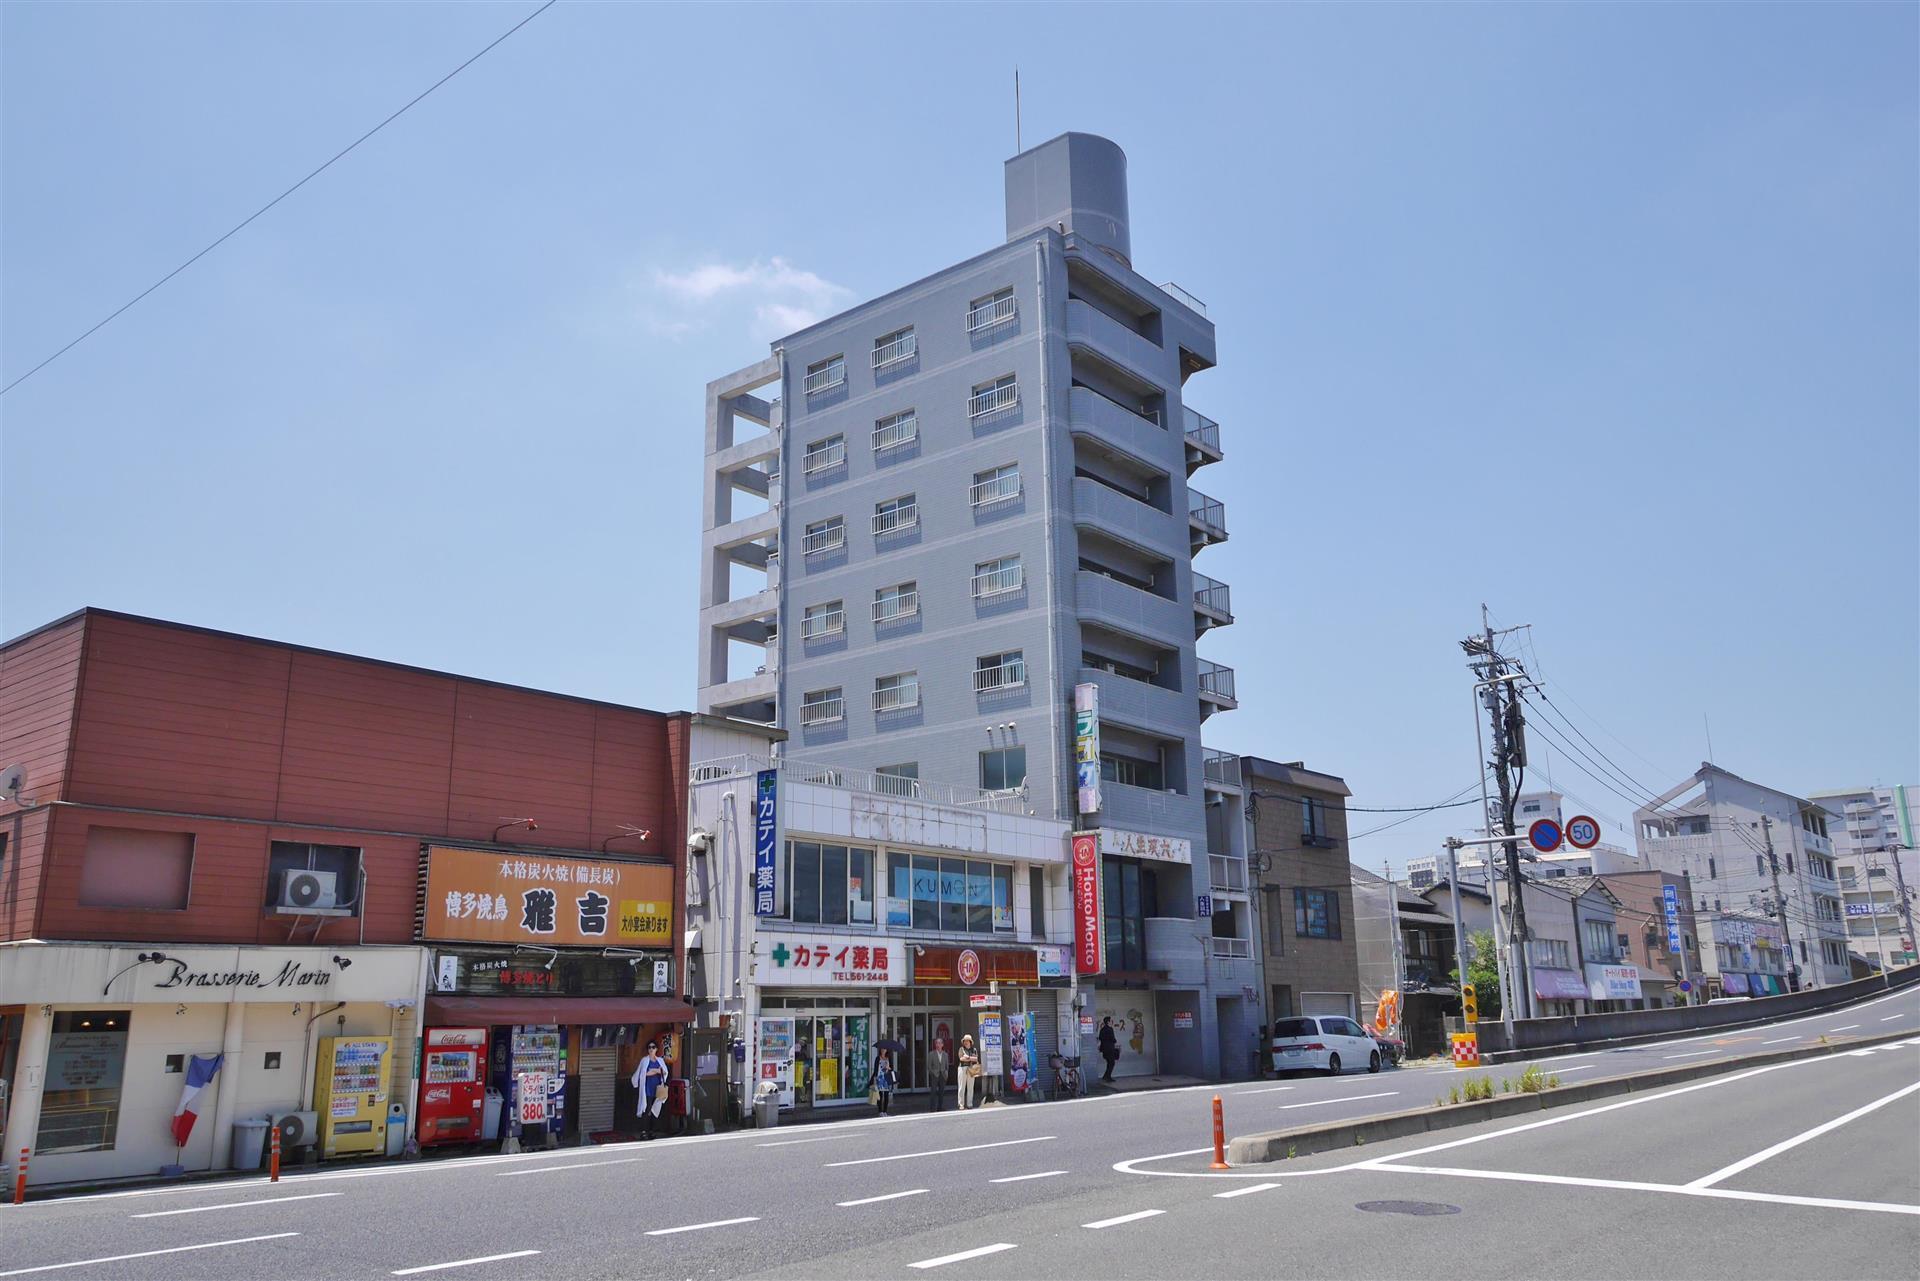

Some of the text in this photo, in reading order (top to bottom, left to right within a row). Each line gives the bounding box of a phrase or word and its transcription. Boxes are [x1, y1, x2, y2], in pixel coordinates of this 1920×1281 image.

[1573, 824, 1593, 840] 50
[757, 796, 774, 913] カテイ薬局
[913, 878, 978, 897] KUMON
[446, 891, 509, 921] 博多焼鳥
[621, 915, 668, 932] 大小宴会承ります
[793, 944, 889, 970] カテイ薬局
[154, 958, 331, 988] Brasserie Marin
[523, 1075, 544, 1084] スーパー
